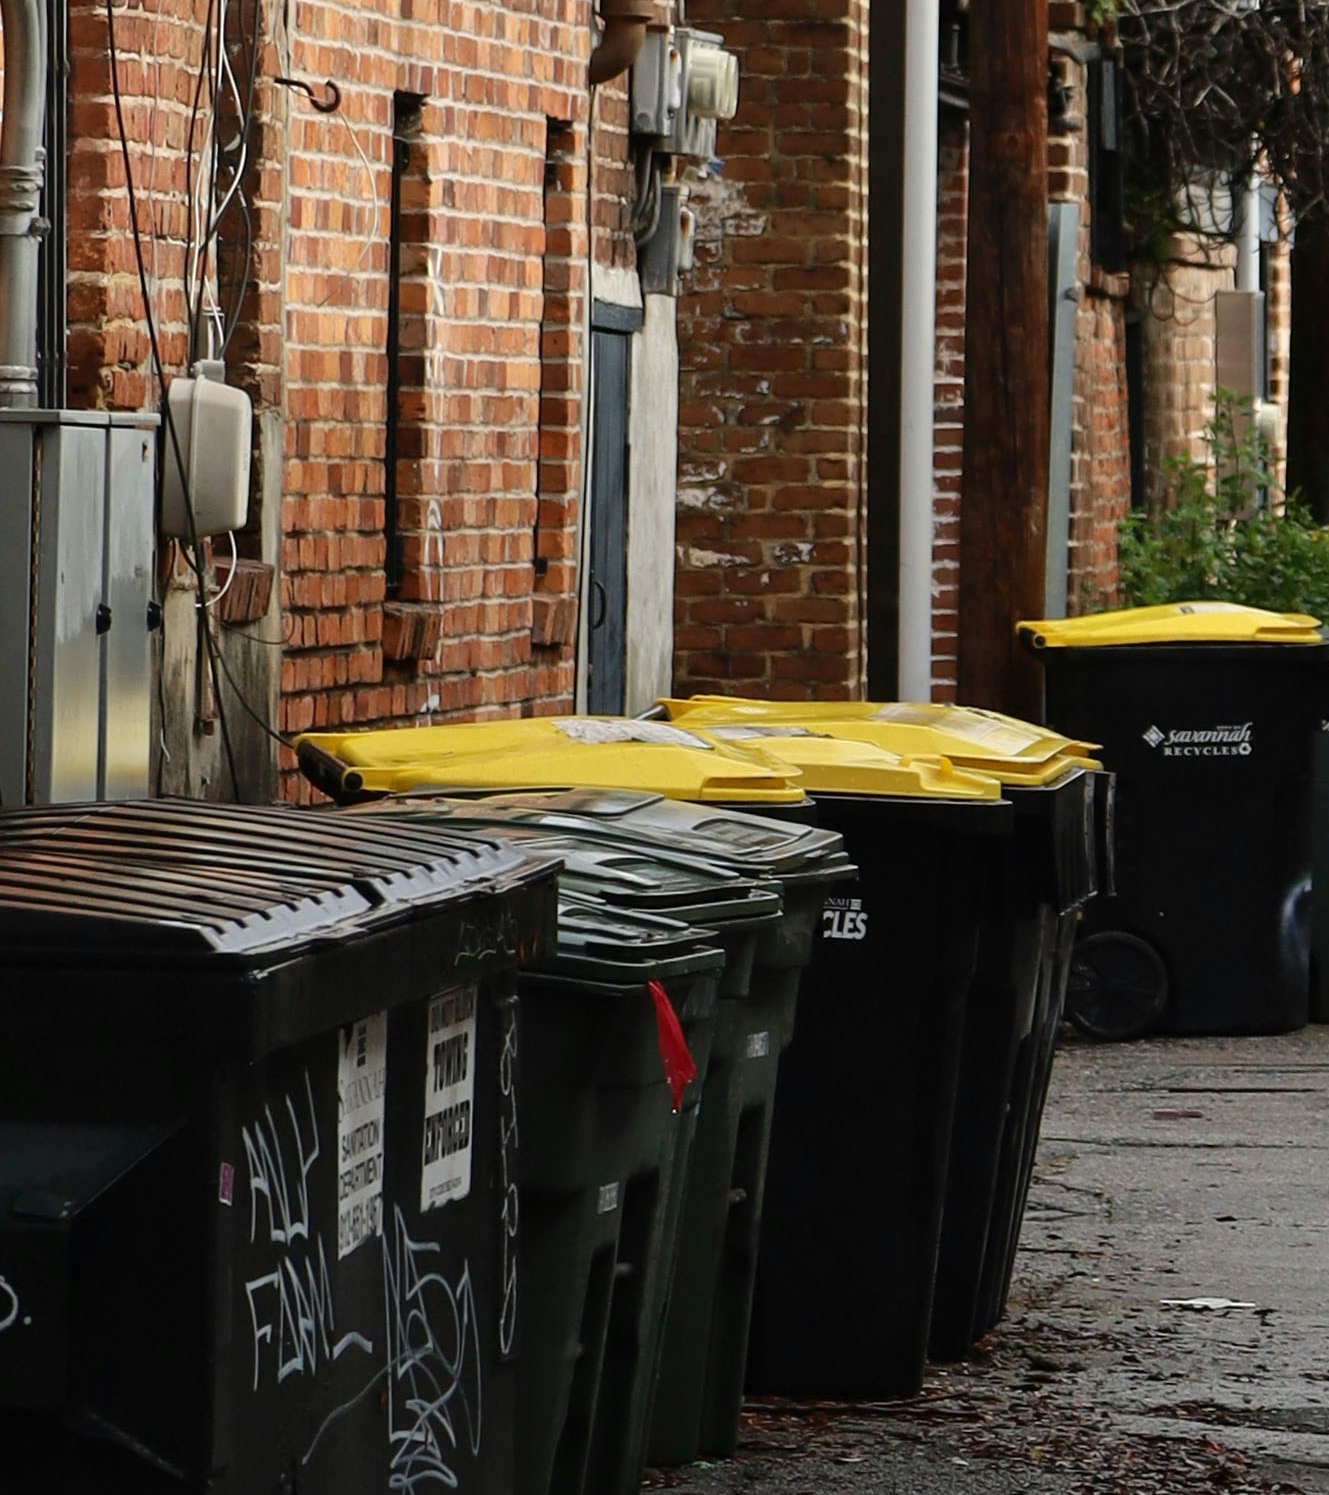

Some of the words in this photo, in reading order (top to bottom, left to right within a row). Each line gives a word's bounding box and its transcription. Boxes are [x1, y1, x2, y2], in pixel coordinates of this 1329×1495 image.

[1163, 722, 1254, 746] savannah
[1163, 746, 1240, 757] RECYCLES
[433, 1030, 469, 1094] TOWING
[341, 1117, 381, 1164] SANITATION
[423, 1099, 472, 1167] ENFORCED
[339, 1152, 383, 1203] DEPARTMENT
